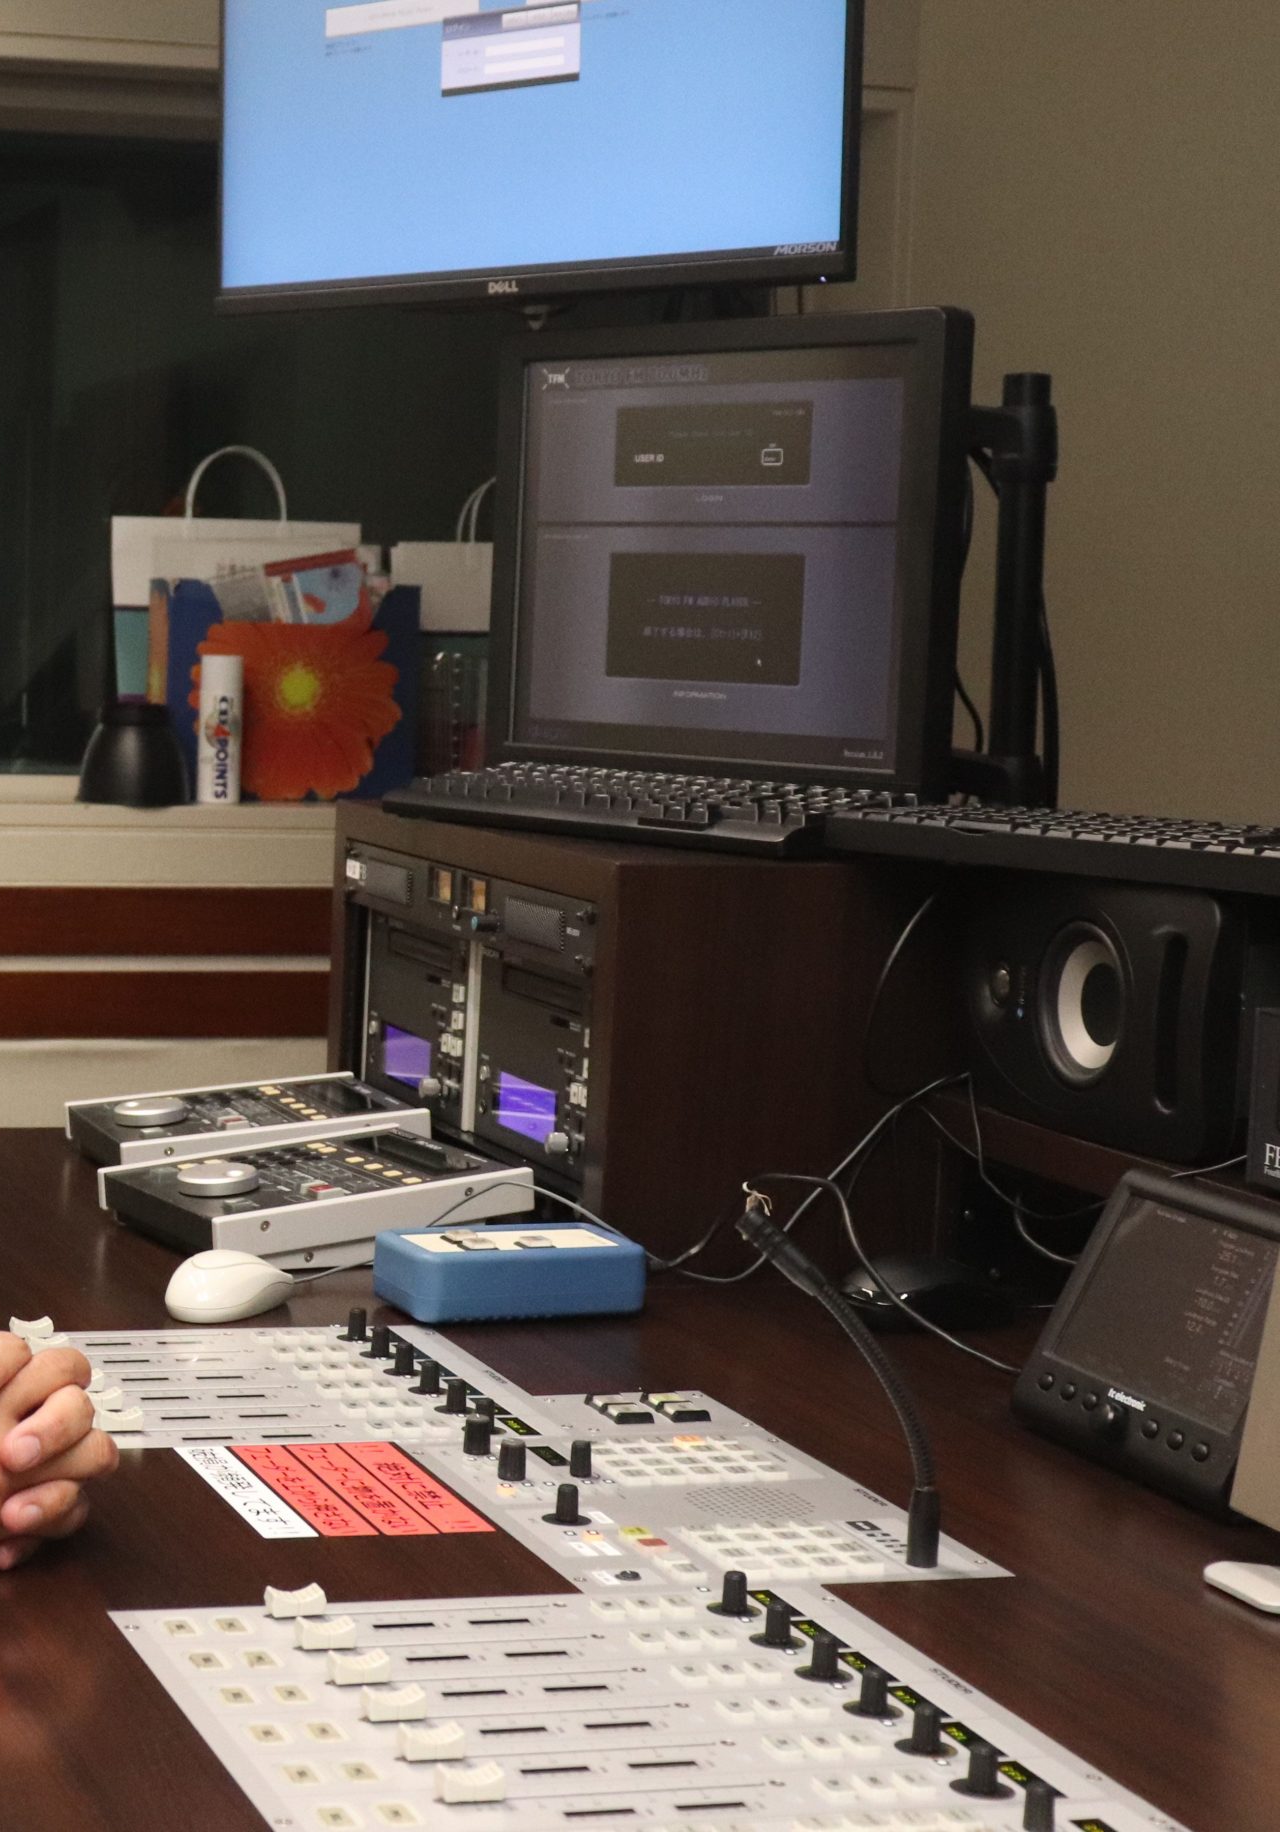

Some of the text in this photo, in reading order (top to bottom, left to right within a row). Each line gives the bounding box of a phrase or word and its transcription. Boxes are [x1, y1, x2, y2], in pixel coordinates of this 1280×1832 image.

[773, 242, 837, 256] MORSON
[487, 280, 519, 295] DELL
[634, 453, 665, 463] USER ID
